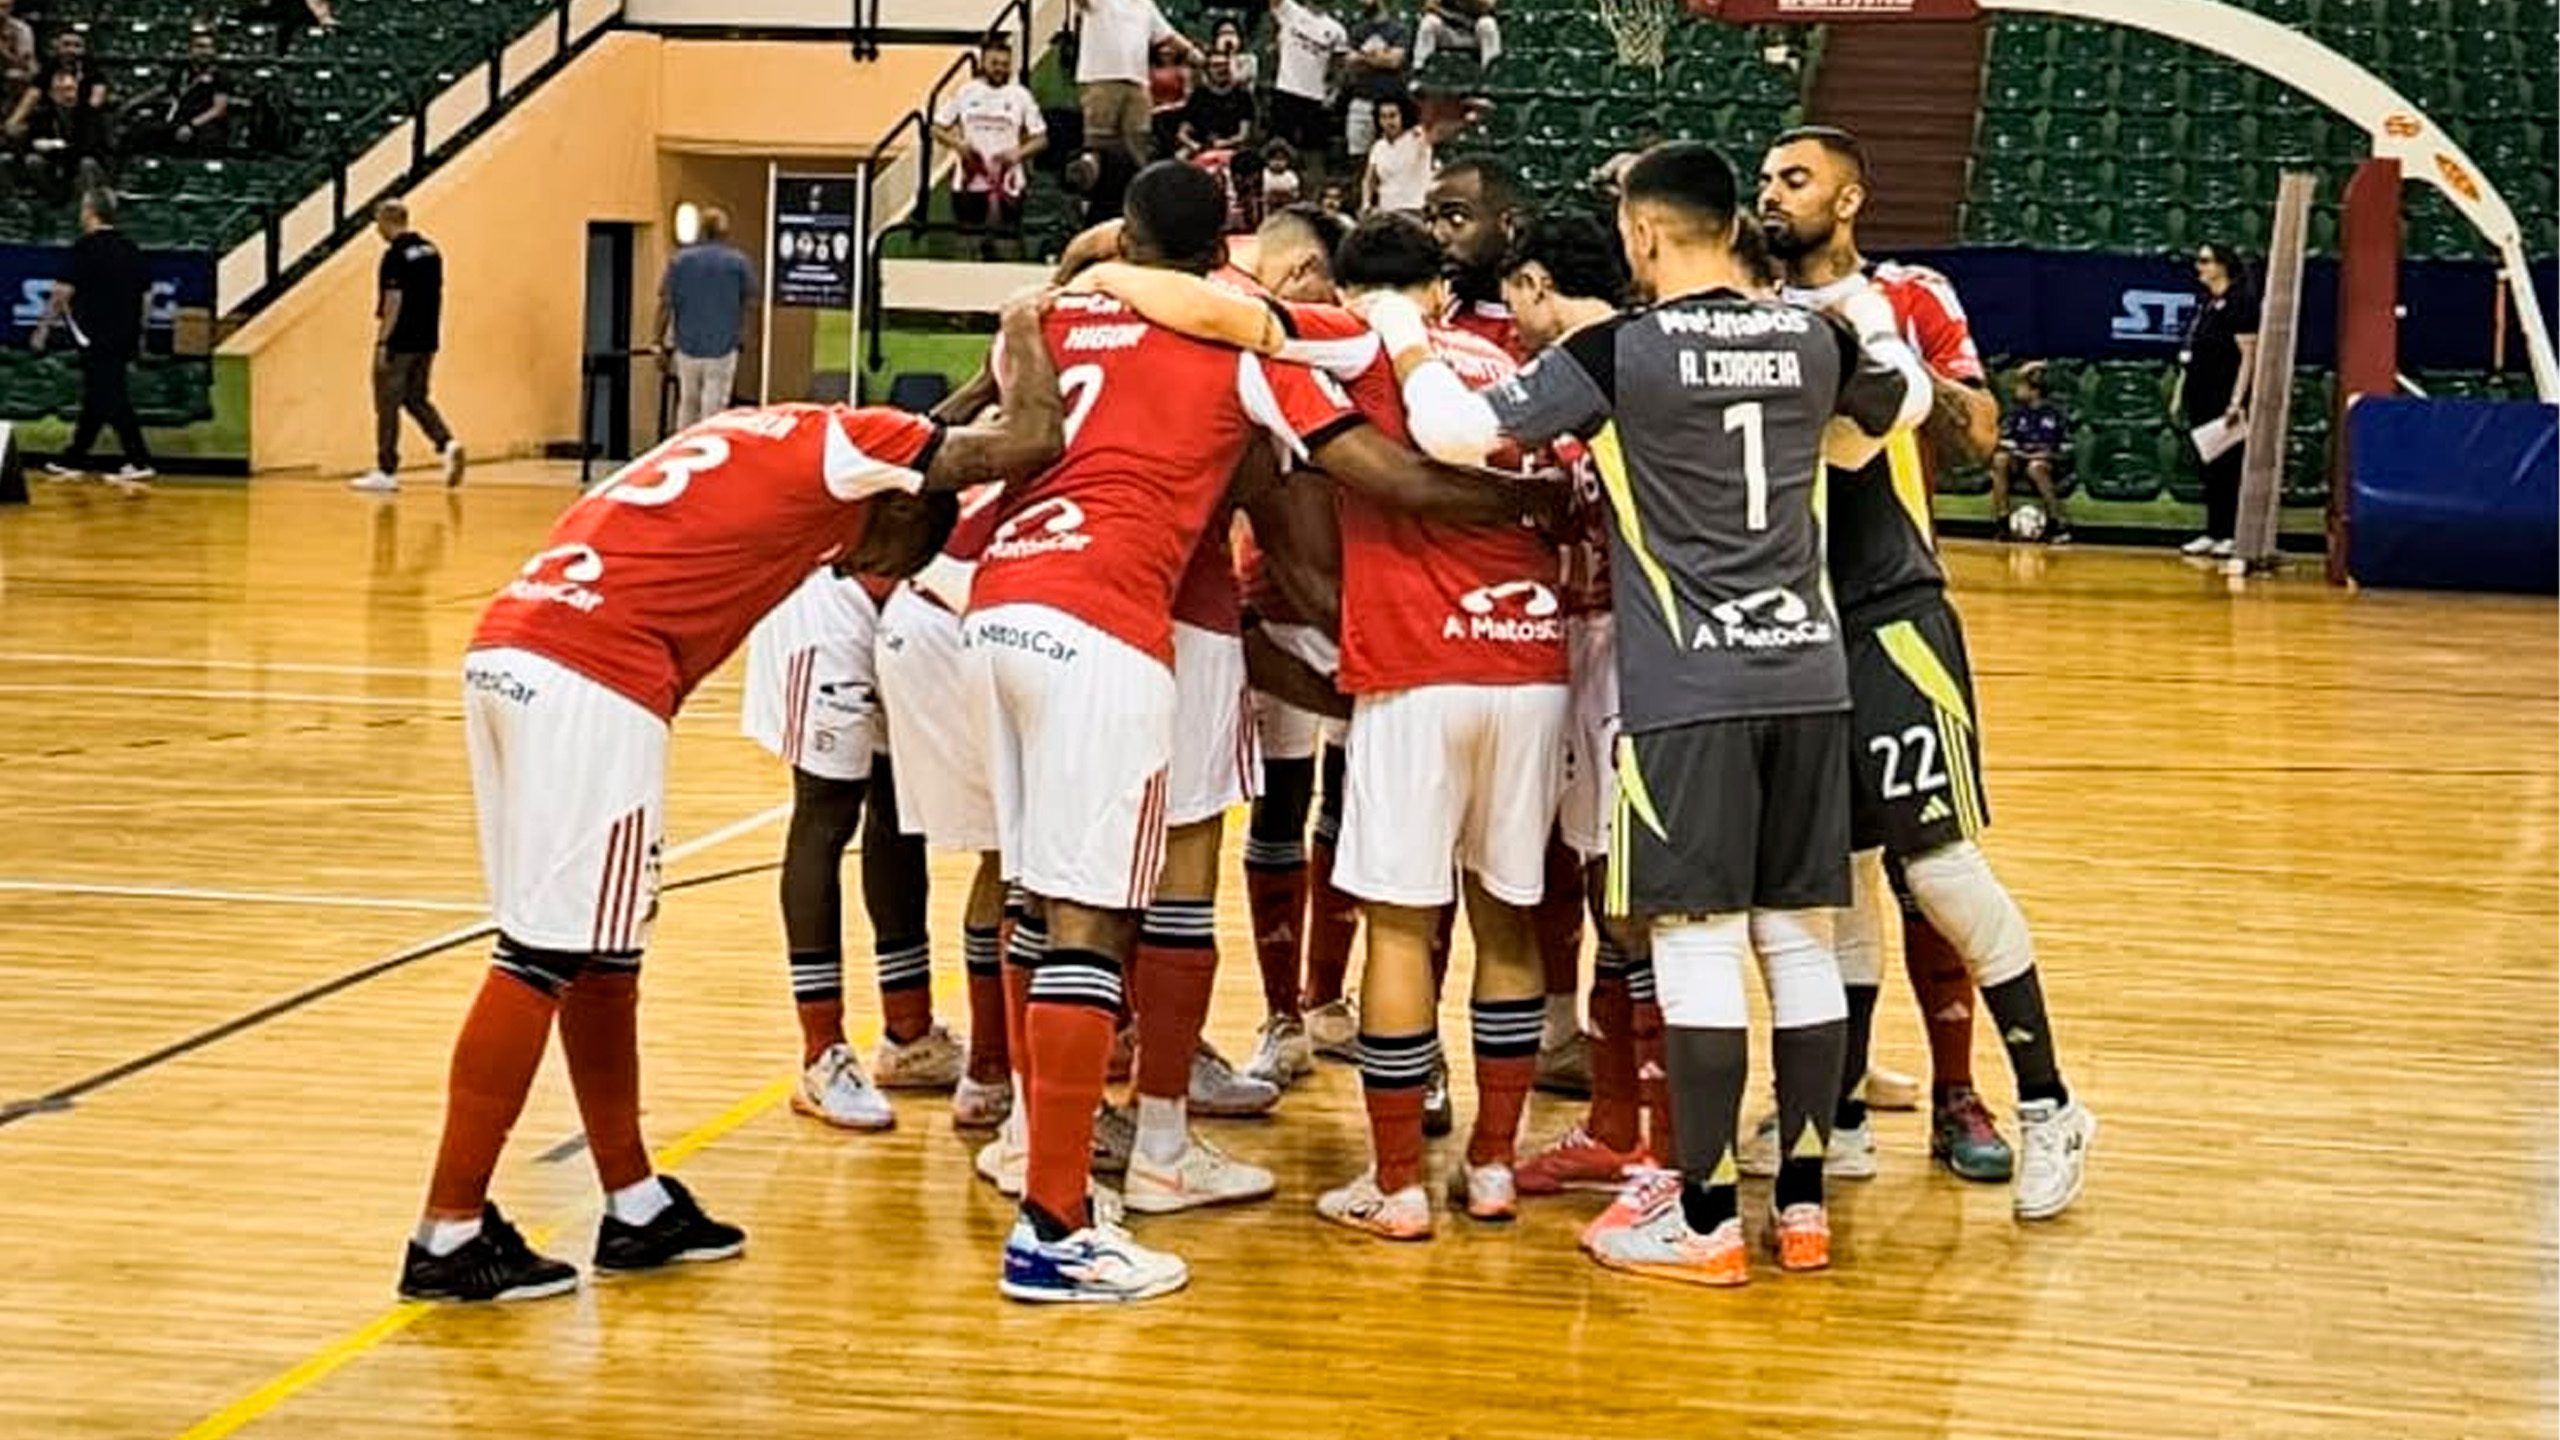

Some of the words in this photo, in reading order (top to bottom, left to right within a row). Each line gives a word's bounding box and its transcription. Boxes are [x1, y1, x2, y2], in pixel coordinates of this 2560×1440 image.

[1706, 350, 1802, 387] CORREIA
[1722, 401, 1768, 530] 1
[1443, 615, 1466, 639] A
[1692, 624, 1718, 650] A
[1869, 725, 1948, 799] 22
